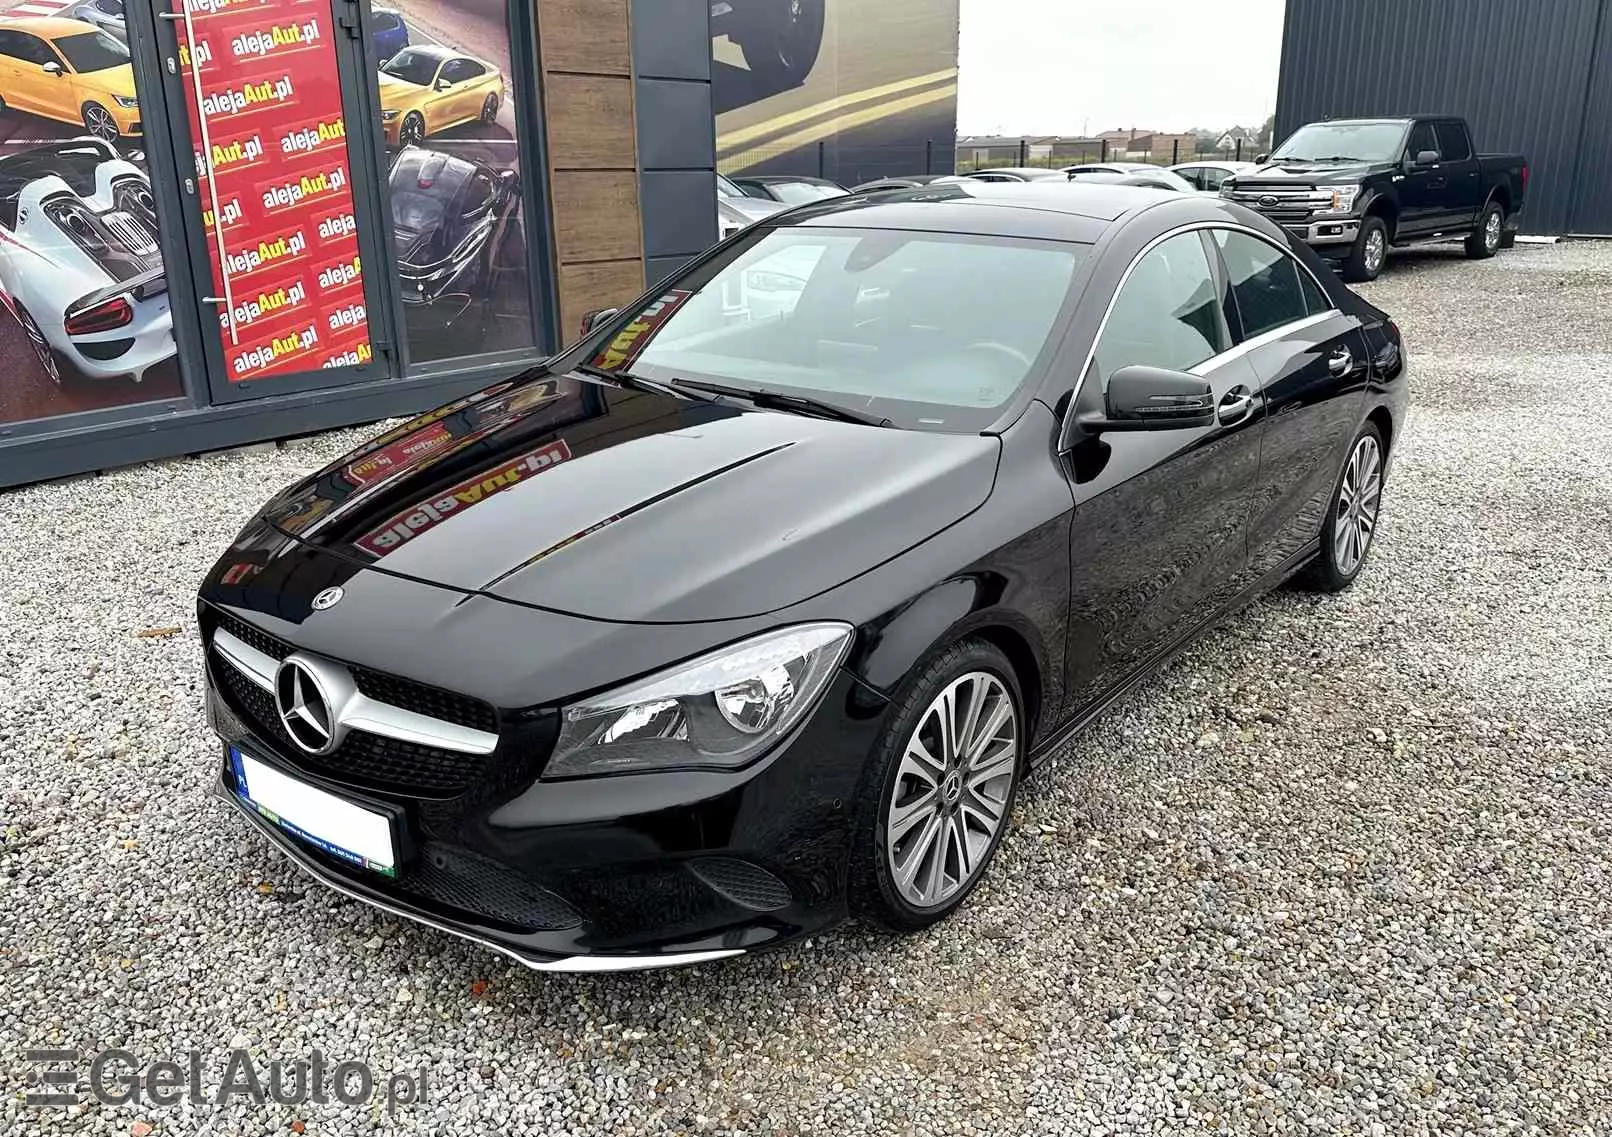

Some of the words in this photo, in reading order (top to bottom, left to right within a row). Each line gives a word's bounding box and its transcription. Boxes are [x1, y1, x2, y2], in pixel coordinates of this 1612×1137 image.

[231, 19, 321, 56] alejaAut.pl
[203, 75, 294, 116] alejaAut.pl
[280, 117, 346, 153] alejaAut
[262, 167, 346, 208] alejaAut.pl
[219, 281, 306, 328] aejaAut.pl
[232, 325, 319, 374] alejaAut.pl
